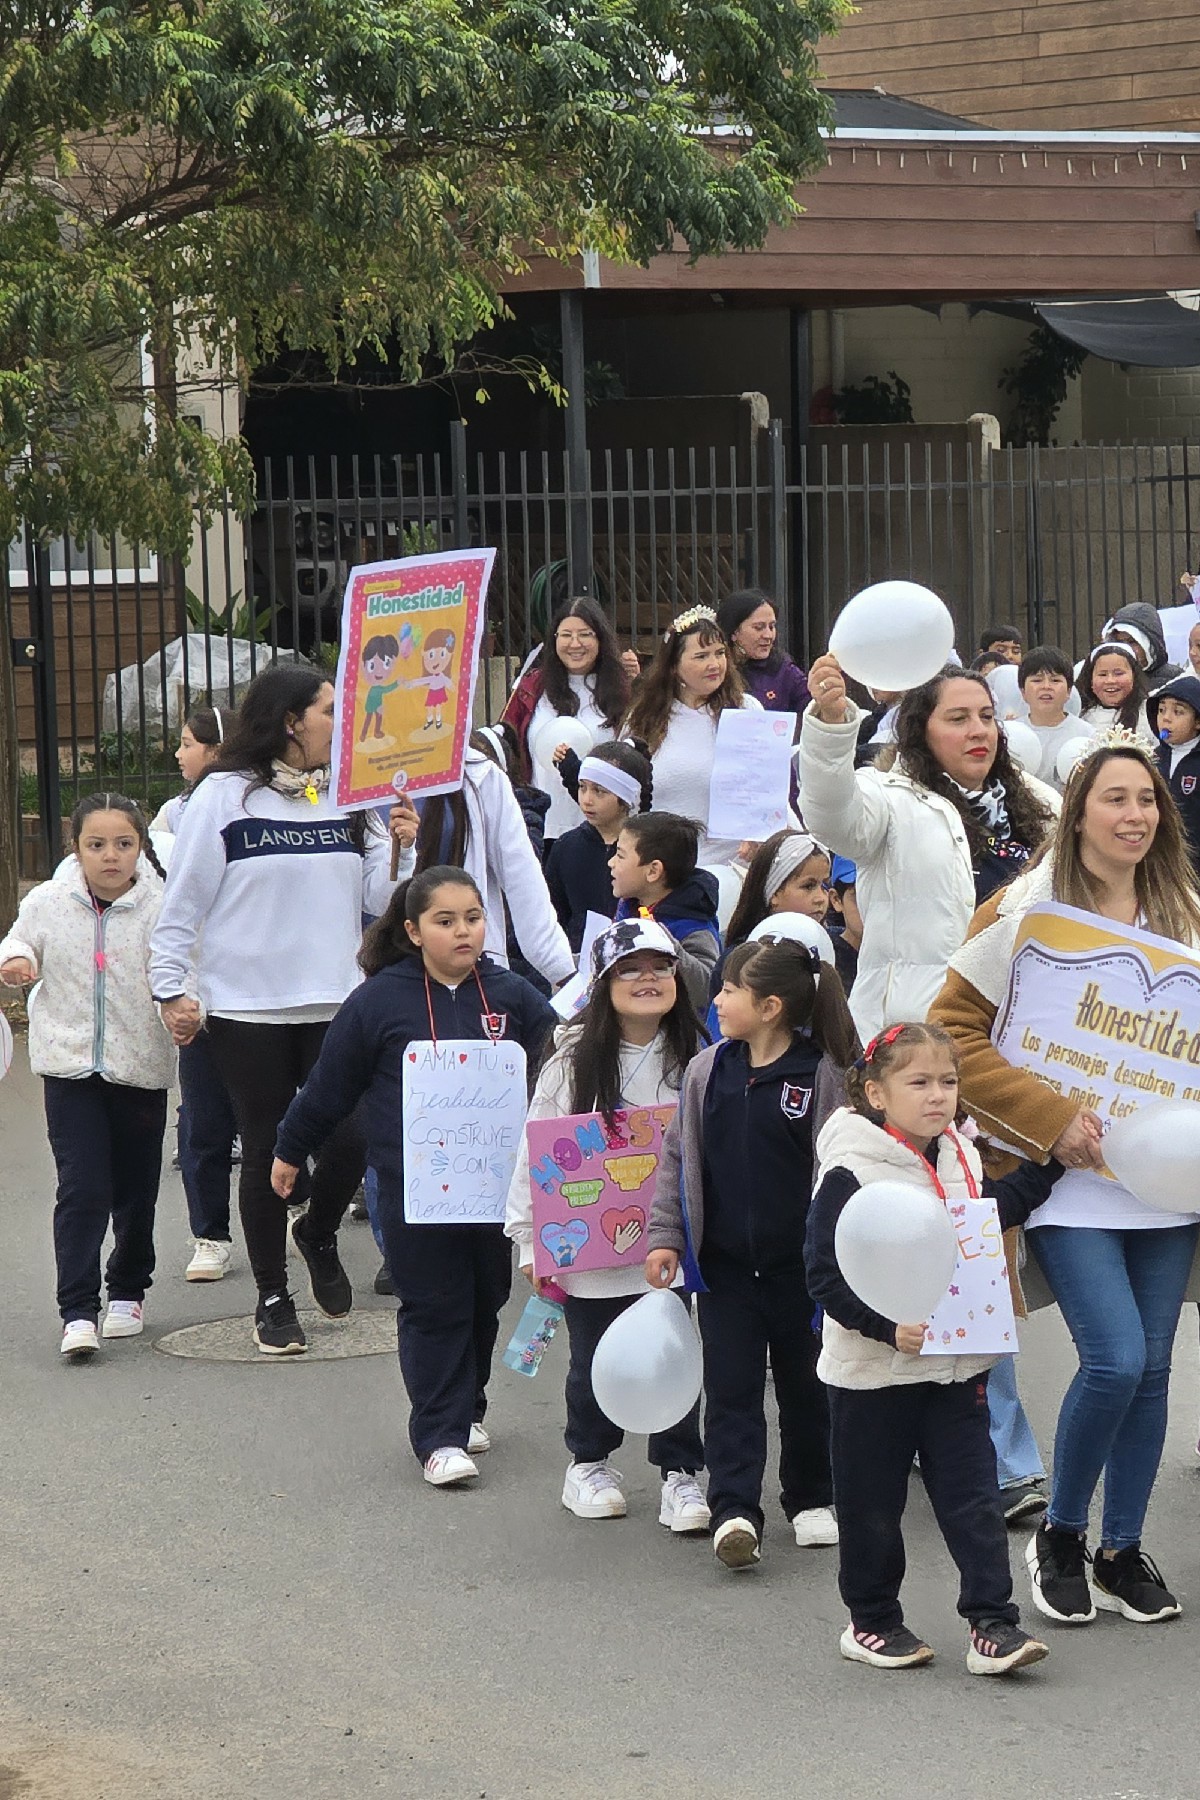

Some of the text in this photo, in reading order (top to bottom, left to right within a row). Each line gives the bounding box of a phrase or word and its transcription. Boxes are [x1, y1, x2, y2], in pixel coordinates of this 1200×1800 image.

[367, 583, 464, 617] Honestidad
[472, 1047, 498, 1071] TU
[1021, 1026, 1042, 1053] Los
[1044, 1041, 1109, 1077] personajes
[1113, 1059, 1176, 1100] descubren
[1109, 1093, 1140, 1118] deci
[453, 1154, 489, 1174] CON
